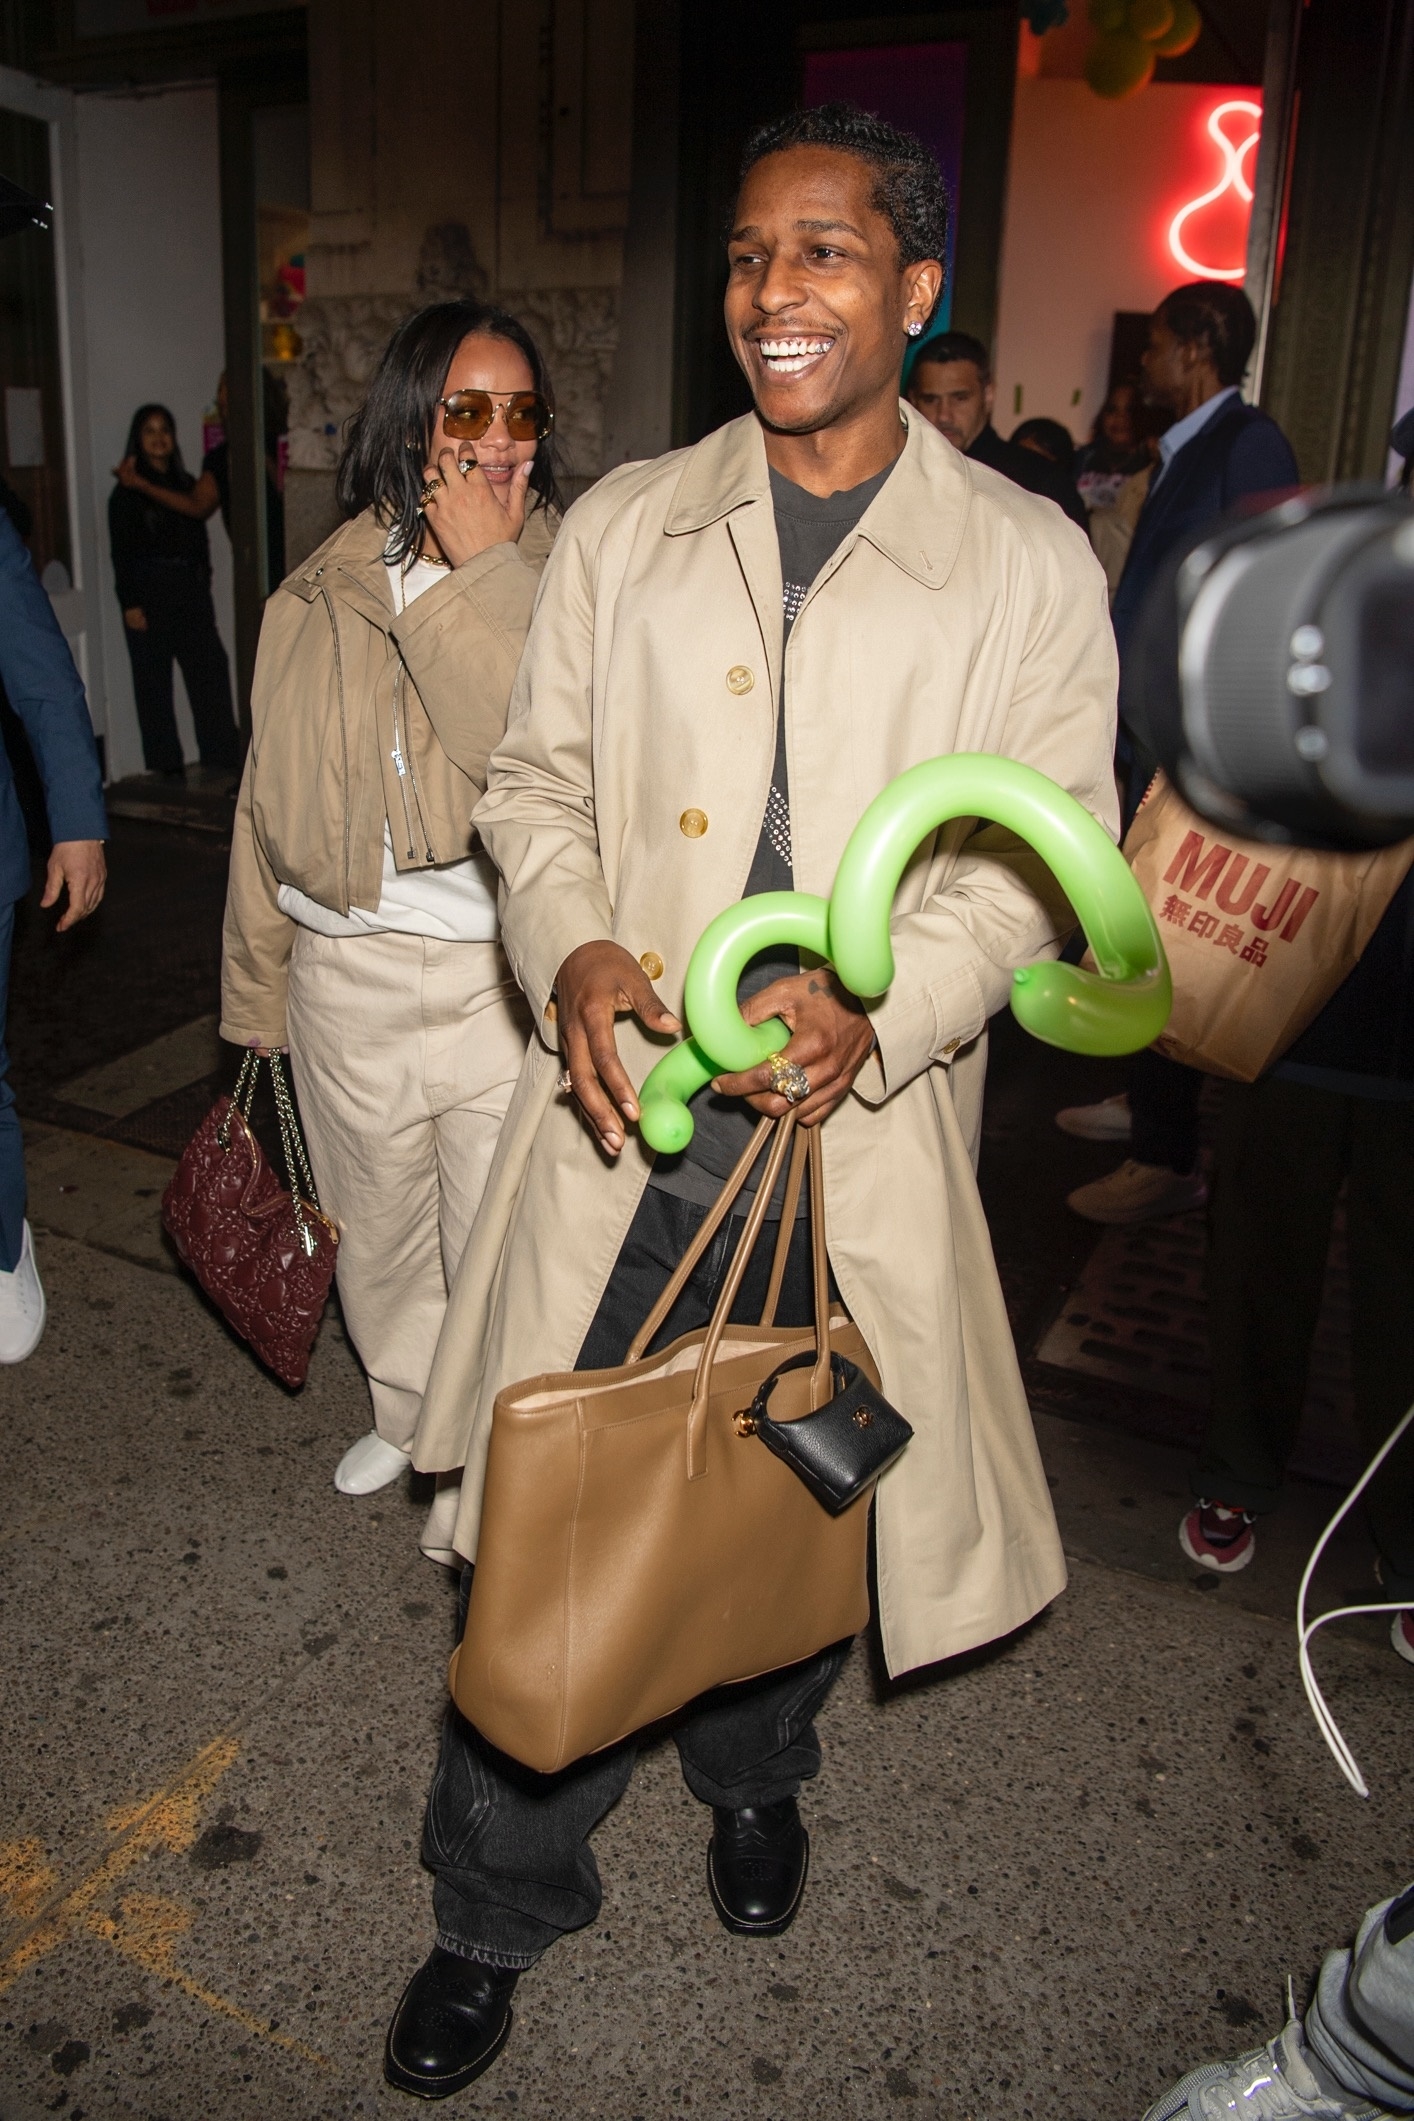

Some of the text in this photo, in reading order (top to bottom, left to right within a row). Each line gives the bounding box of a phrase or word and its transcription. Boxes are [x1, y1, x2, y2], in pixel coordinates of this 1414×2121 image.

[1160, 895, 1270, 968] 無印良品
[1163, 830, 1320, 943] MUJI
